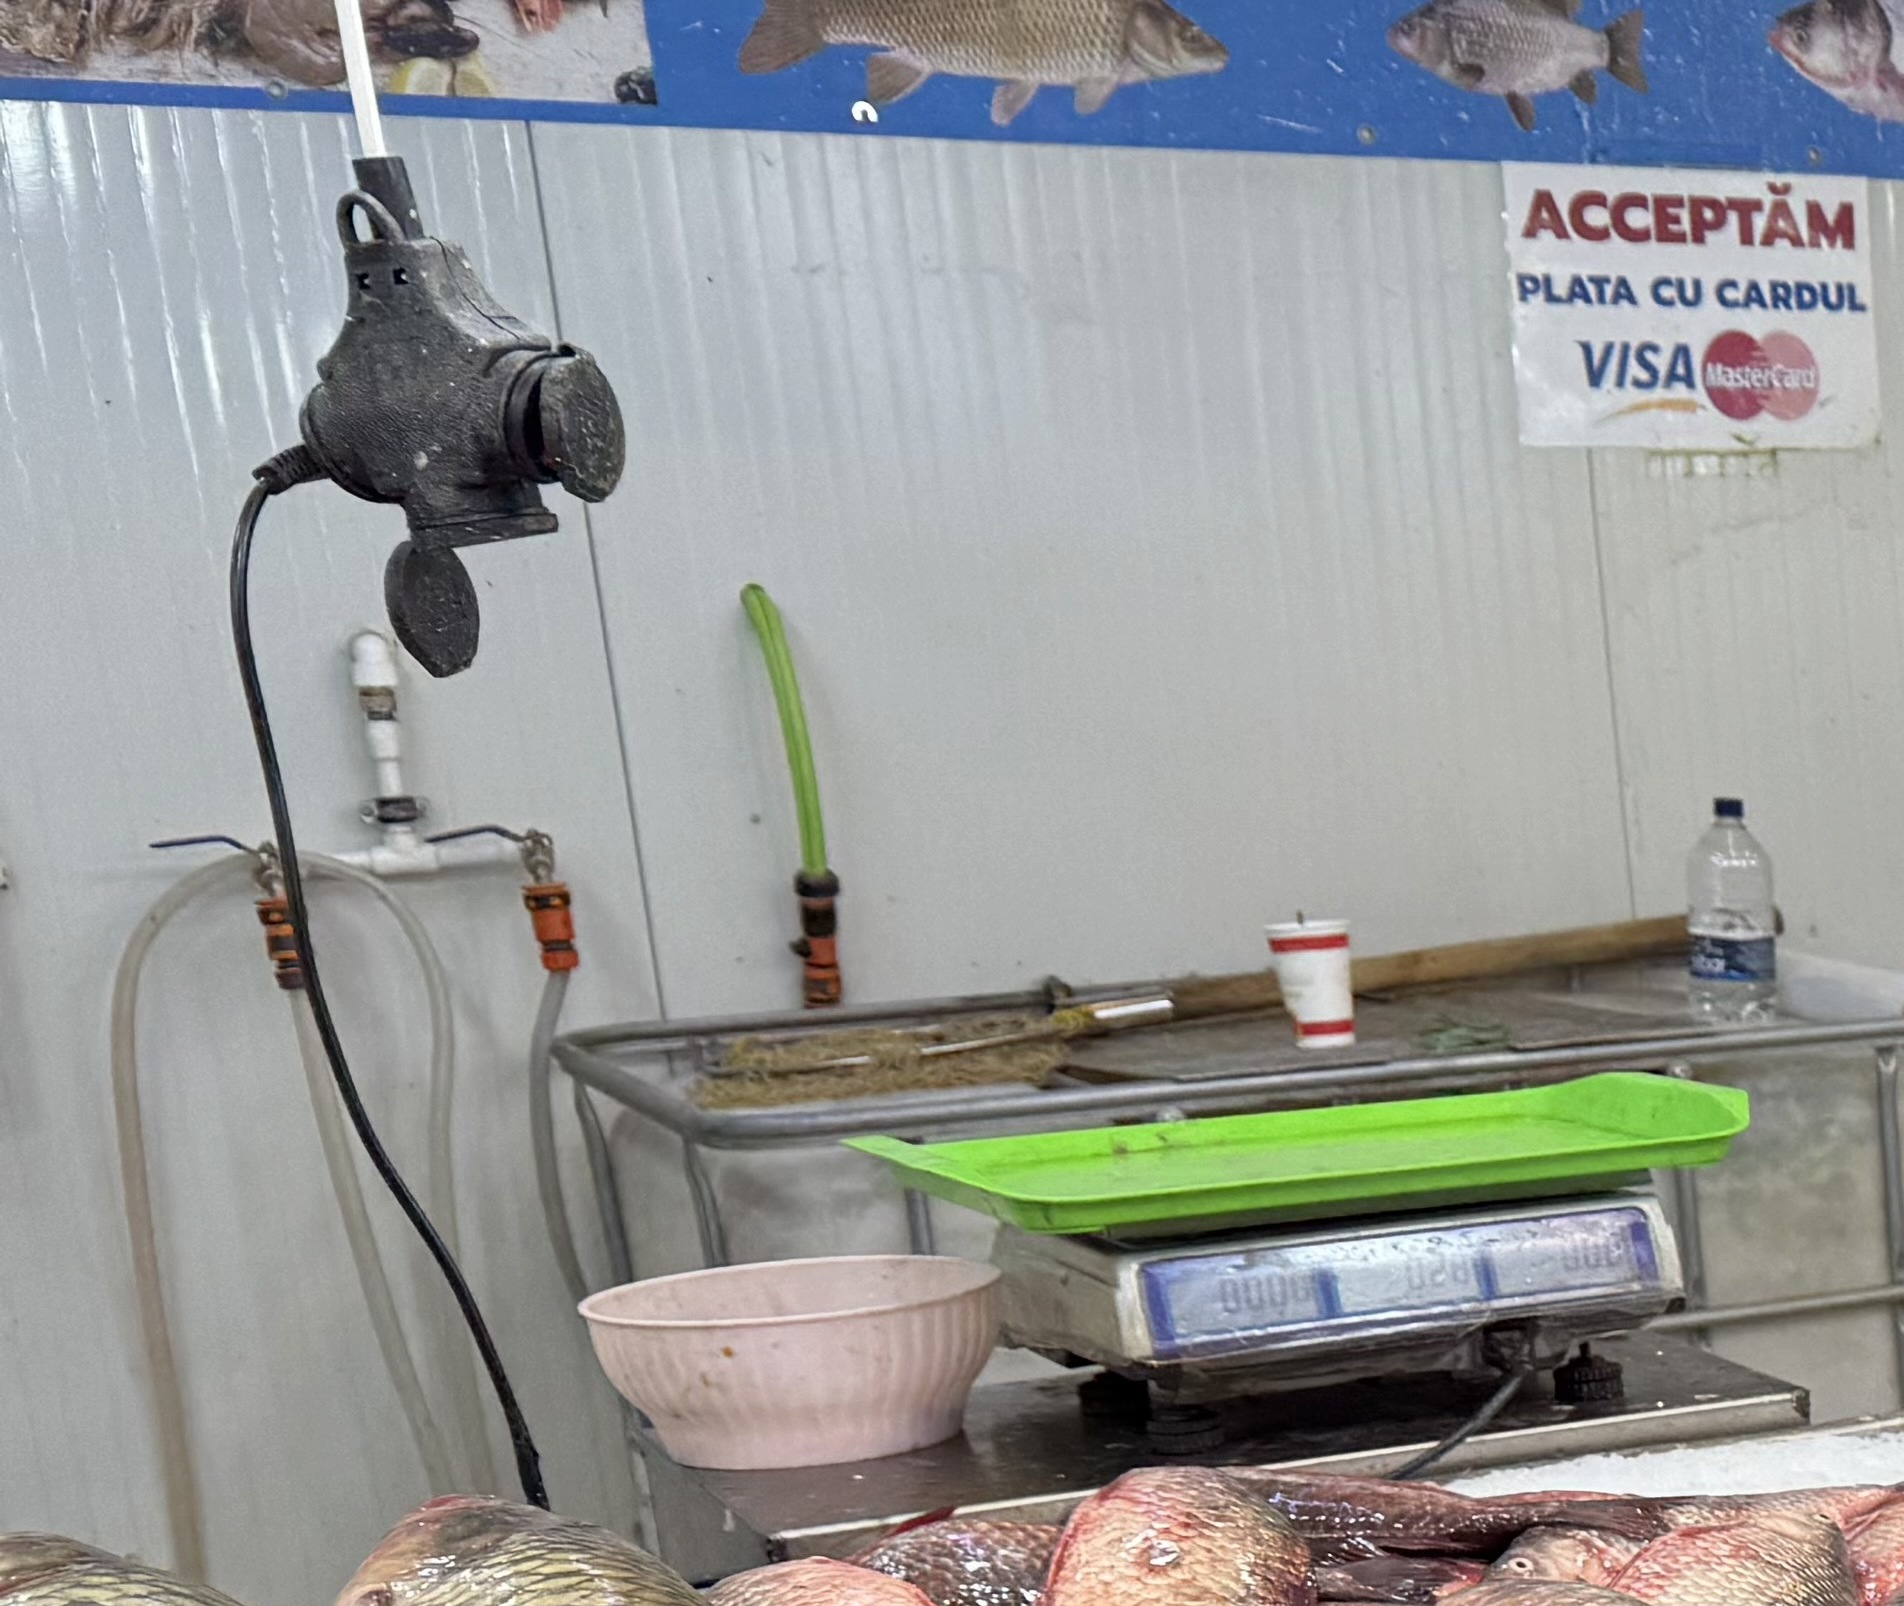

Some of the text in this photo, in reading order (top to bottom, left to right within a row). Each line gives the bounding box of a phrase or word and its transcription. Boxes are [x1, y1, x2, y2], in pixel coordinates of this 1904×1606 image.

[1521, 181, 1856, 250] ACCEPTĂM
[1517, 272, 1867, 312] PLATA CU CARDUL
[1574, 340, 1818, 392] VISA MasterCard
